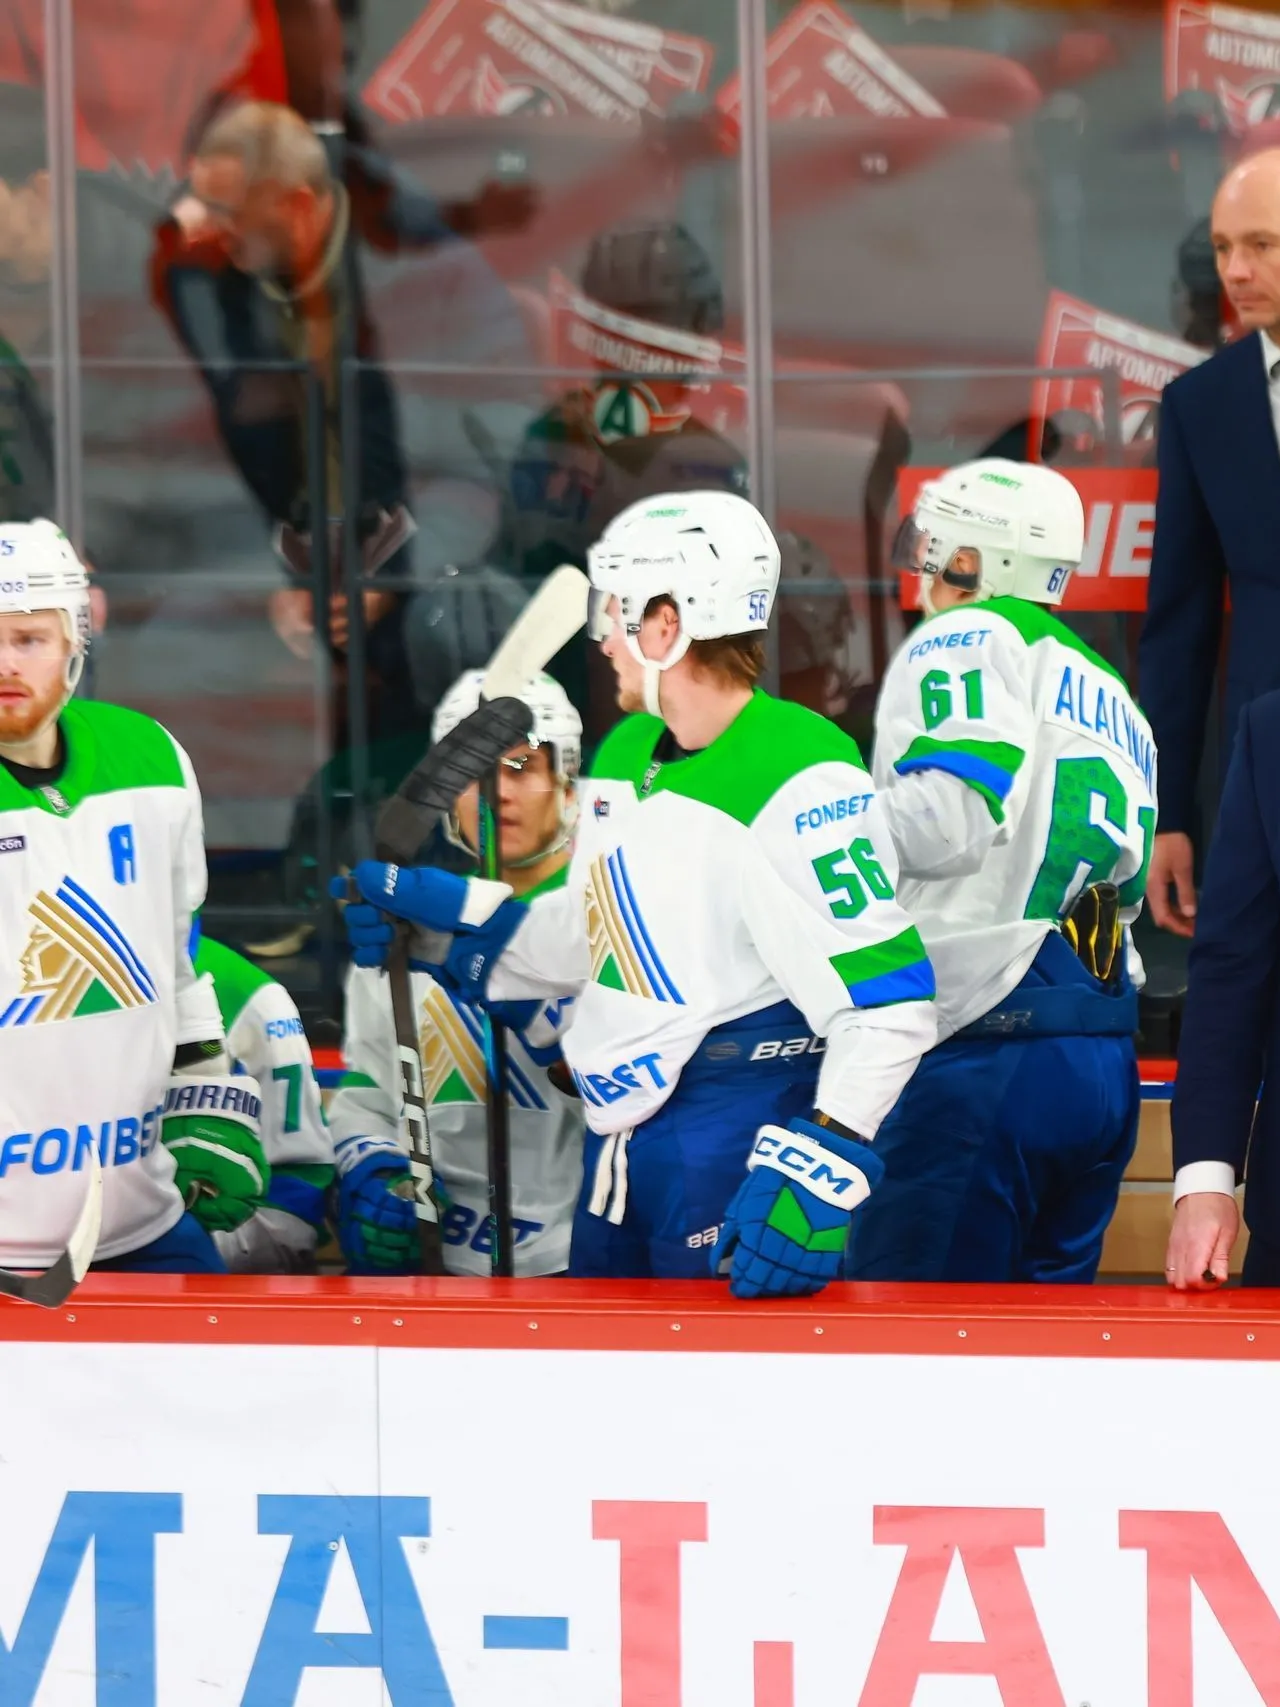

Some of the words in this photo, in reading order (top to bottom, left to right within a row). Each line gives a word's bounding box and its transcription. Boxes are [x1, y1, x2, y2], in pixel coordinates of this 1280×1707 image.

[1047, 567, 1068, 596] 61
[749, 593, 767, 621] 56
[908, 628, 993, 664] FONBET
[919, 668, 985, 733] 61
[795, 793, 875, 835] FONBET
[811, 837, 895, 919] 56
[749, 1037, 828, 1062] BAU
[755, 1135, 854, 1196] CCM
